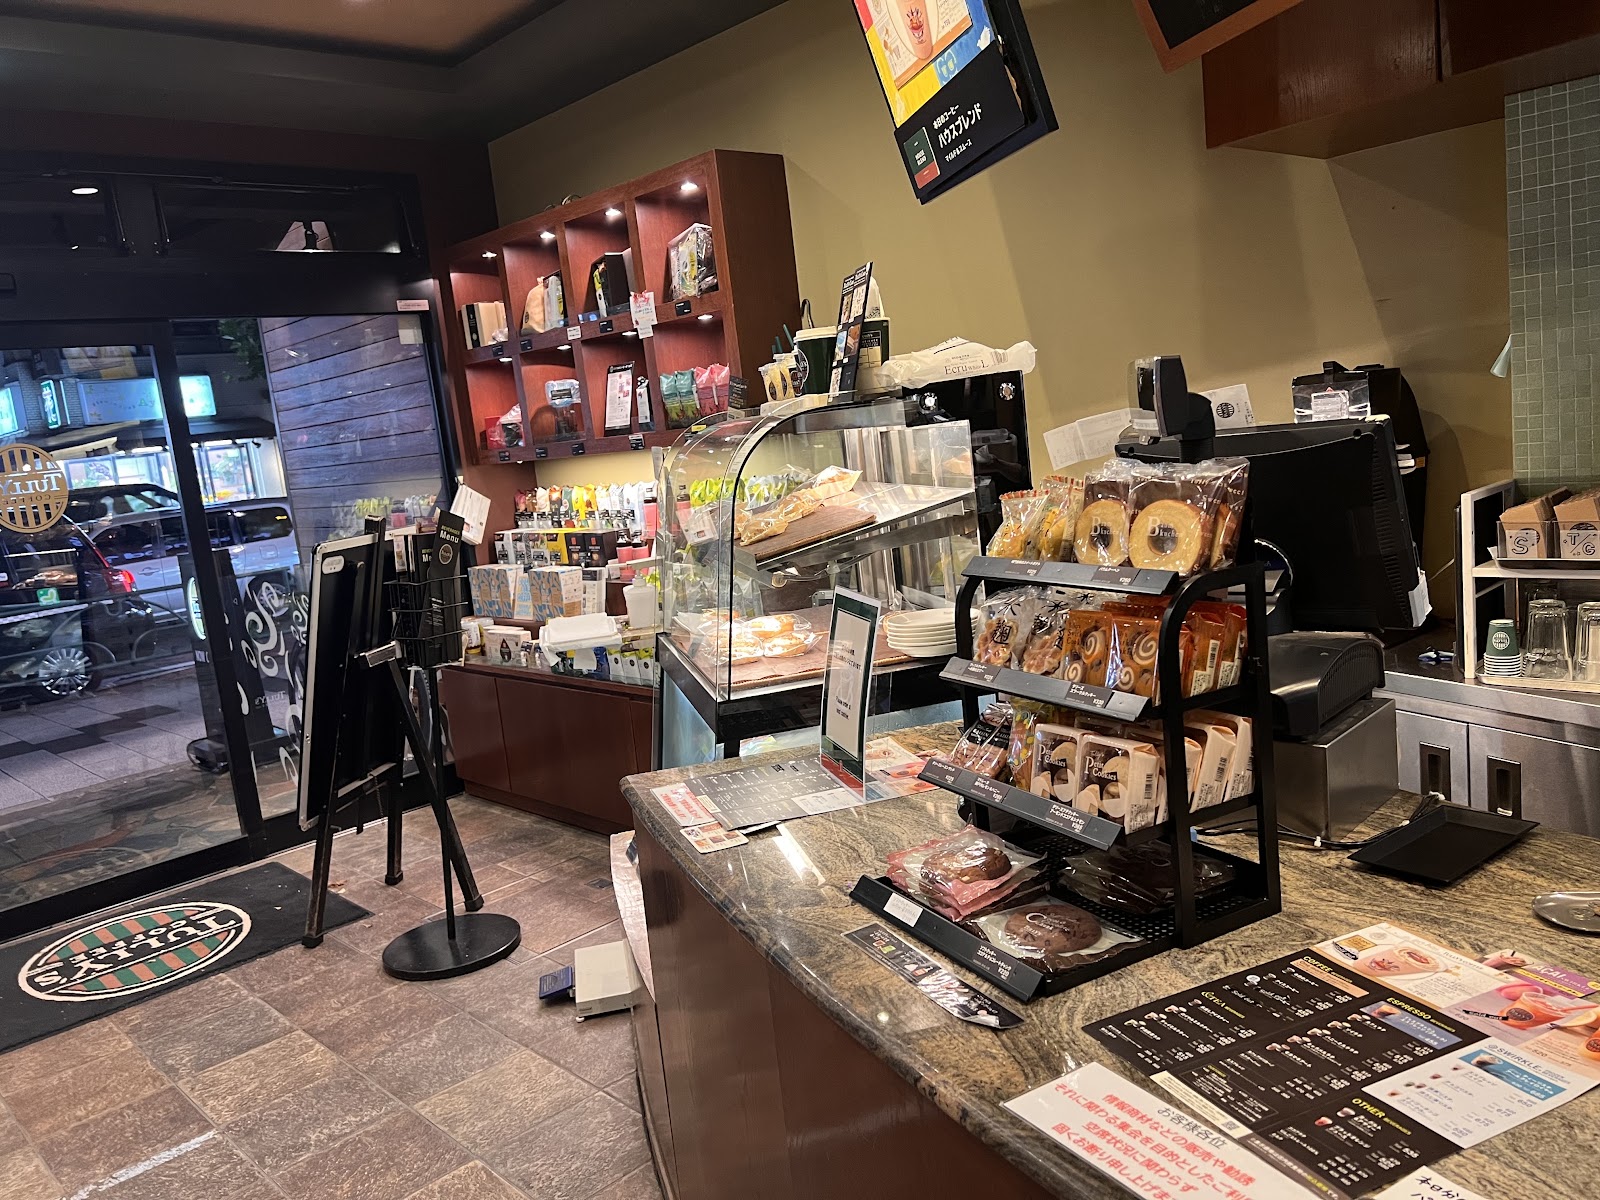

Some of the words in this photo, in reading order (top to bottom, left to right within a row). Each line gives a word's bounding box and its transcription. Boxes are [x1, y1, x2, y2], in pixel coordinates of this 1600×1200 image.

[933, 104, 960, 130] 本日のコーヒー
[938, 102, 982, 149] ハウスブレンド
[944, 365, 968, 375] Ecru
[980, 359, 989, 368] L
[440, 530, 459, 543] Menu
[1512, 536, 1529, 555] S
[1085, 756, 1105, 774] Petit
[1092, 767, 1117, 781] Cookies
[34, 916, 236, 986] TULLY'S
[69, 920, 187, 964] COFFEE
[1303, 956, 1333, 972] COFFEE
[1386, 997, 1431, 1019] ESPRESSO
[1497, 1048, 1542, 1071] SWIRKLE
[1352, 1098, 1385, 1118] OTHER
[1102, 1093, 1256, 1187] 情報商材などの販売や勧誘
[1157, 1106, 1228, 1150] お客様各位
[1053, 1082, 1253, 1200] それに関わる集会を目的としたご利
[1051, 1121, 1177, 1200] 固くお断り申し上げま
[1082, 1120, 1200, 1194] 空席状況に関わらず
[1415, 1175, 1466, 1200] 本日分
